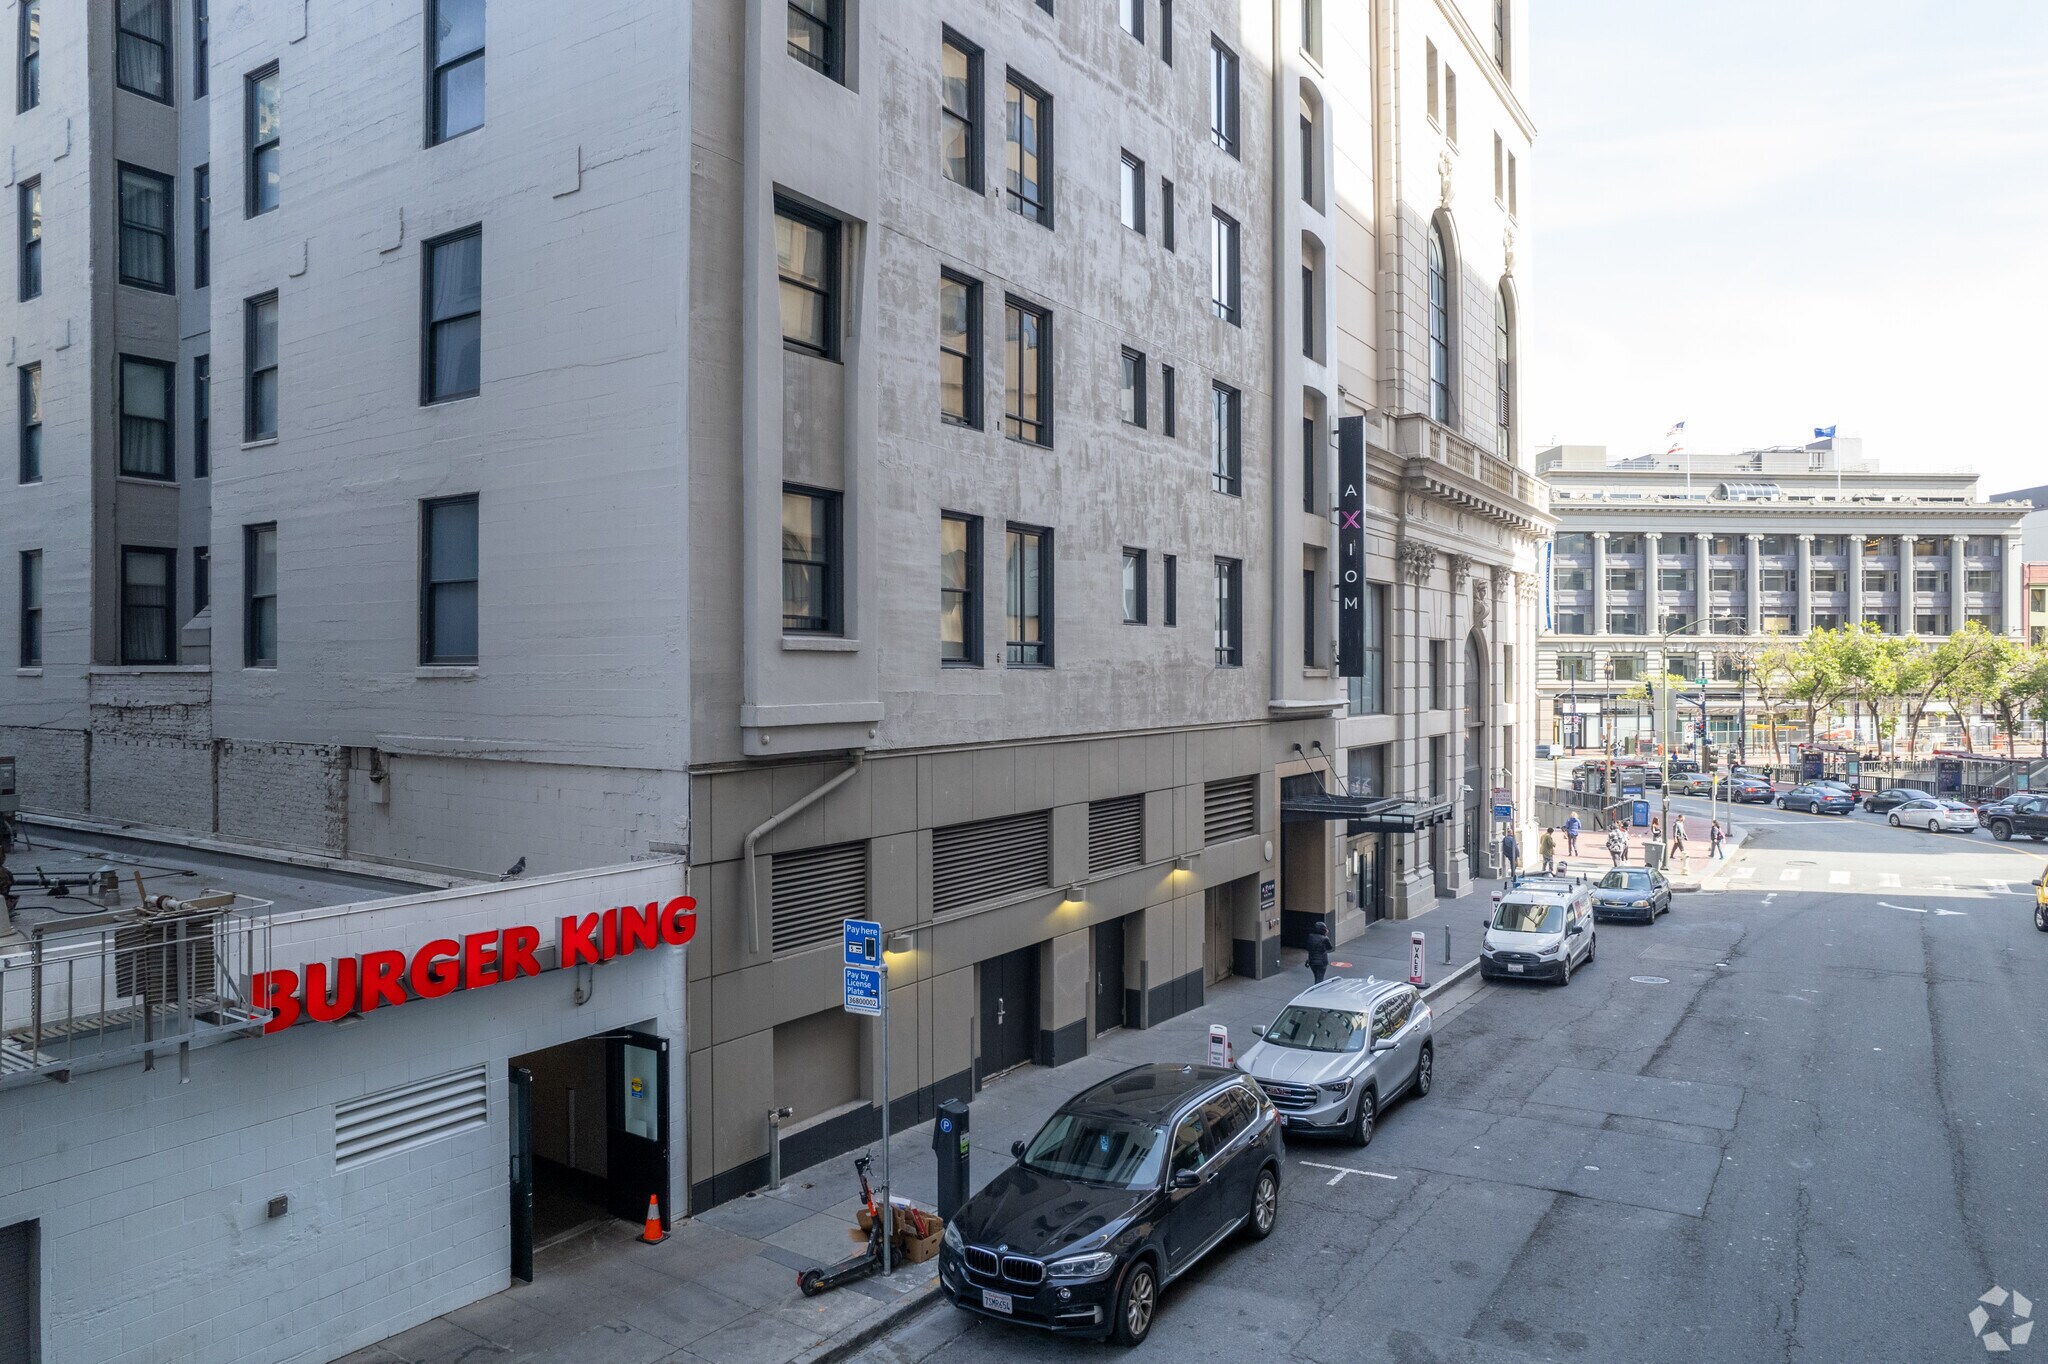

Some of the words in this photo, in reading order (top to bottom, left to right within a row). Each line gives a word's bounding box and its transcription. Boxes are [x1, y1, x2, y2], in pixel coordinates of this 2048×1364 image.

[1341, 484, 1361, 610] AXIOM
[846, 924, 860, 935] Pay
[860, 925, 878, 936] here
[251, 925, 542, 1034] BURGER
[559, 896, 697, 969] KING
[846, 970, 860, 980] Pay
[860, 971, 870, 981] by
[847, 978, 871, 989] License
[847, 986, 864, 996] Plate
